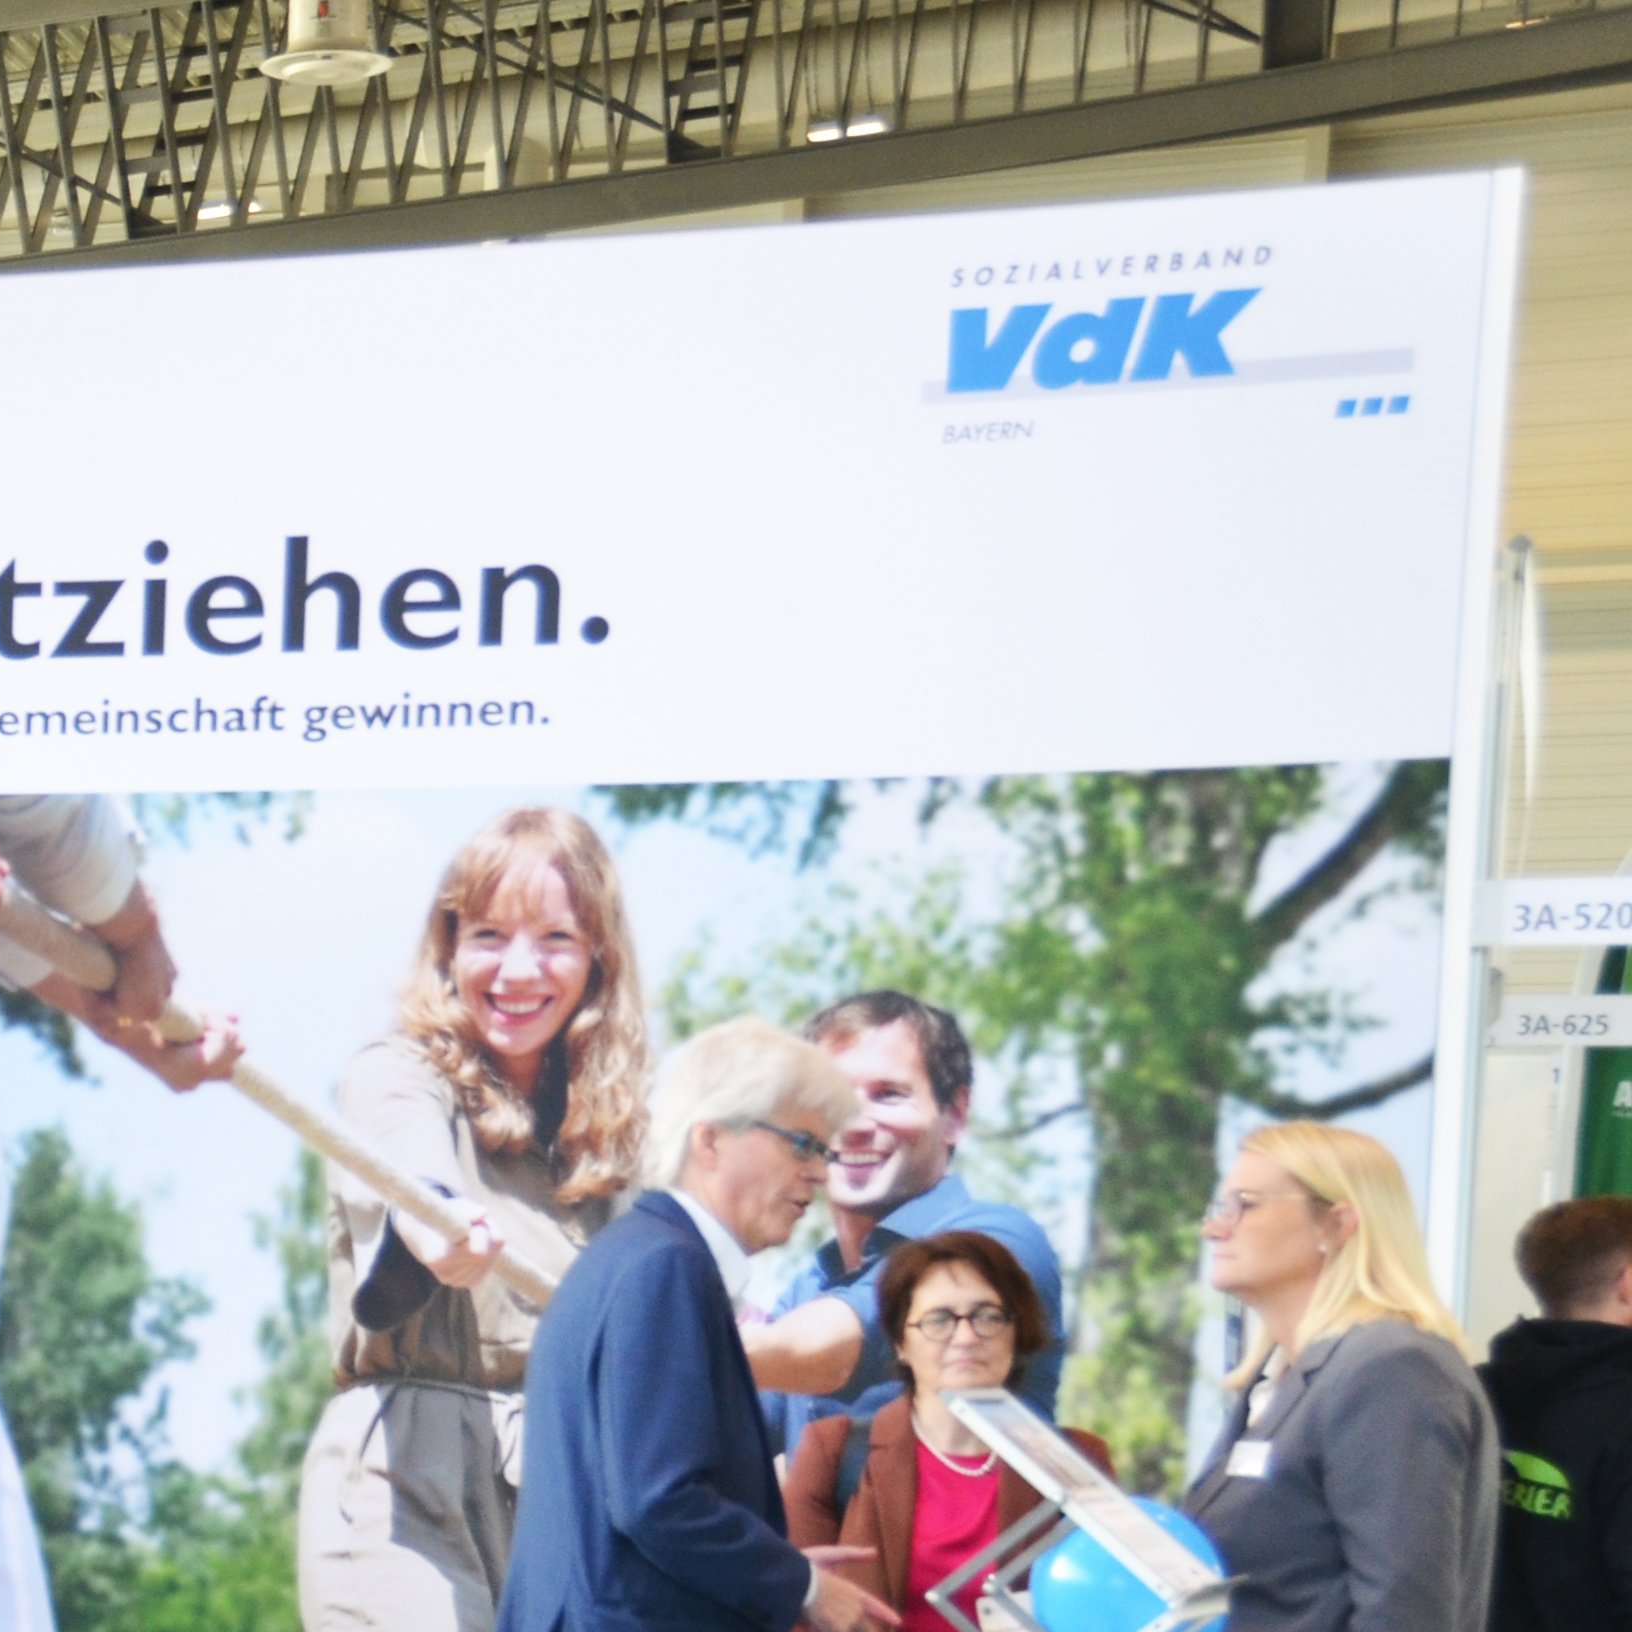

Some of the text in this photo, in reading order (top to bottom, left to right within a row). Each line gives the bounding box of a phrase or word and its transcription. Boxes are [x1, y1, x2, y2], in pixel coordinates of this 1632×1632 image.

[950, 246, 1274, 288] SOZIALVERBAND
[946, 287, 1264, 392] VdK
[941, 420, 1034, 444] BAYERN
[302, 693, 551, 743] gewinnen.
[1512, 902, 1632, 932] 3A-520
[1517, 1014, 1609, 1036] 3A-625
